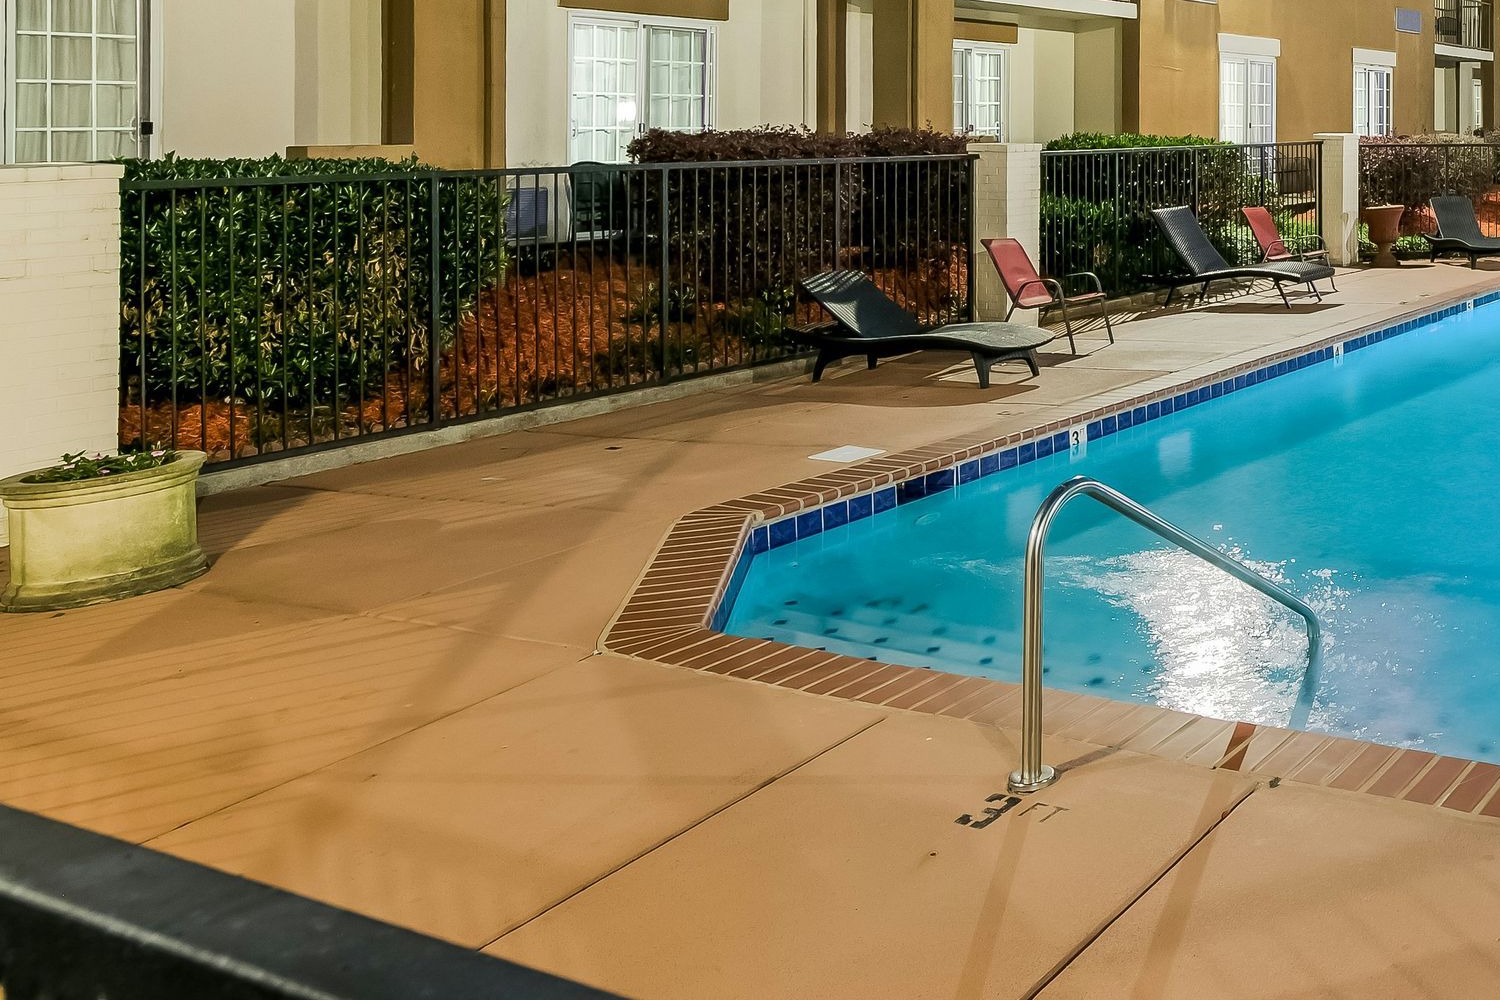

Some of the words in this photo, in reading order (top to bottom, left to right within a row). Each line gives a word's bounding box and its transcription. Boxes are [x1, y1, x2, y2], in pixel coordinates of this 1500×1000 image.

[1072, 430, 1080, 446] 3
[953, 793, 1023, 830] 3
[1018, 802, 1070, 823] FT
